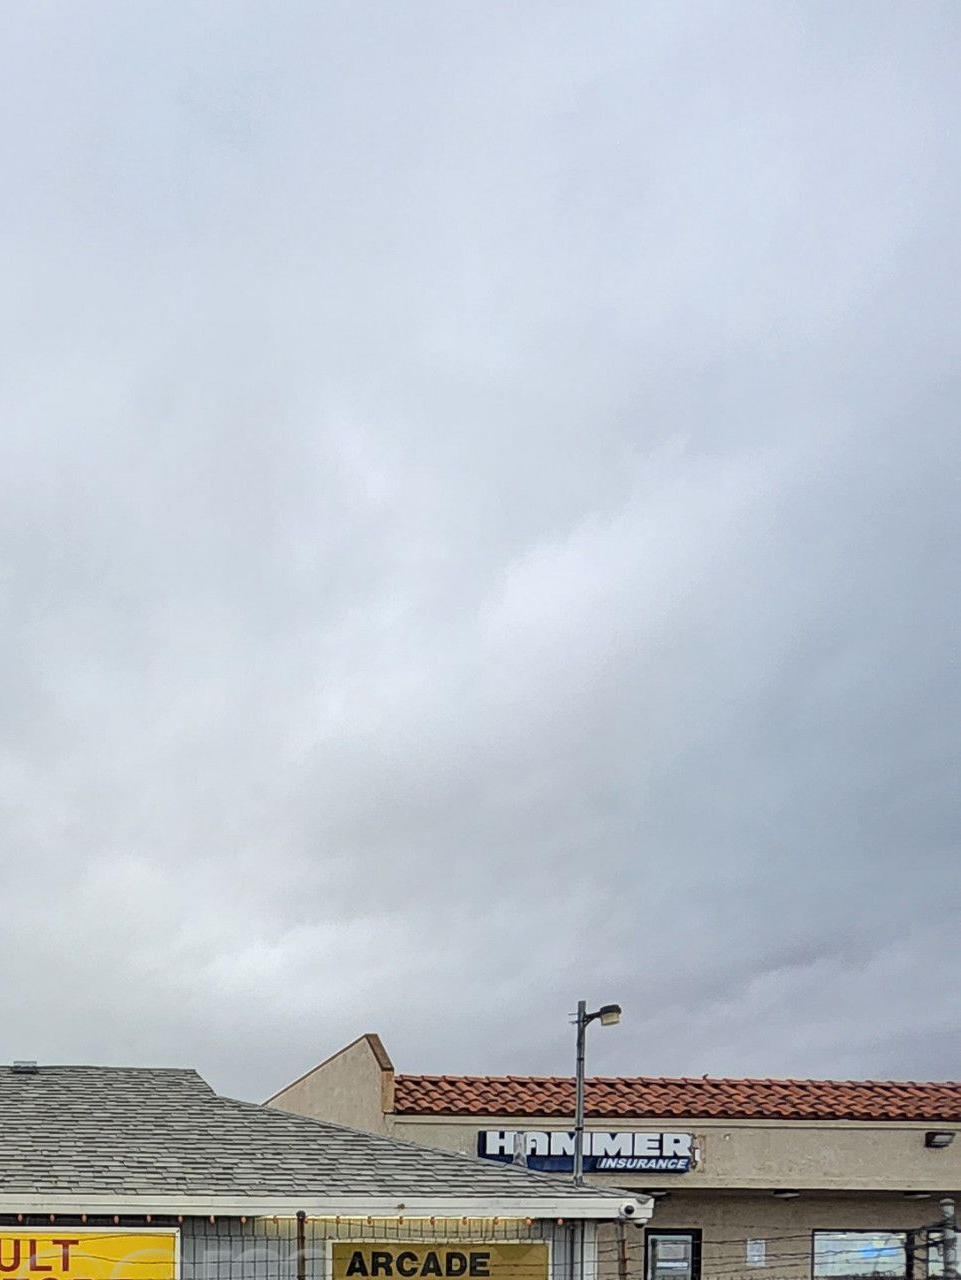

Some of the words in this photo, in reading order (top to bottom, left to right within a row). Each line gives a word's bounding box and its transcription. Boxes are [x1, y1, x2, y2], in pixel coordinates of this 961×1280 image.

[485, 1131, 693, 1156] HAMMER
[600, 1158, 688, 1170] INSURANCE
[346, 1251, 491, 1277] ARCADE
